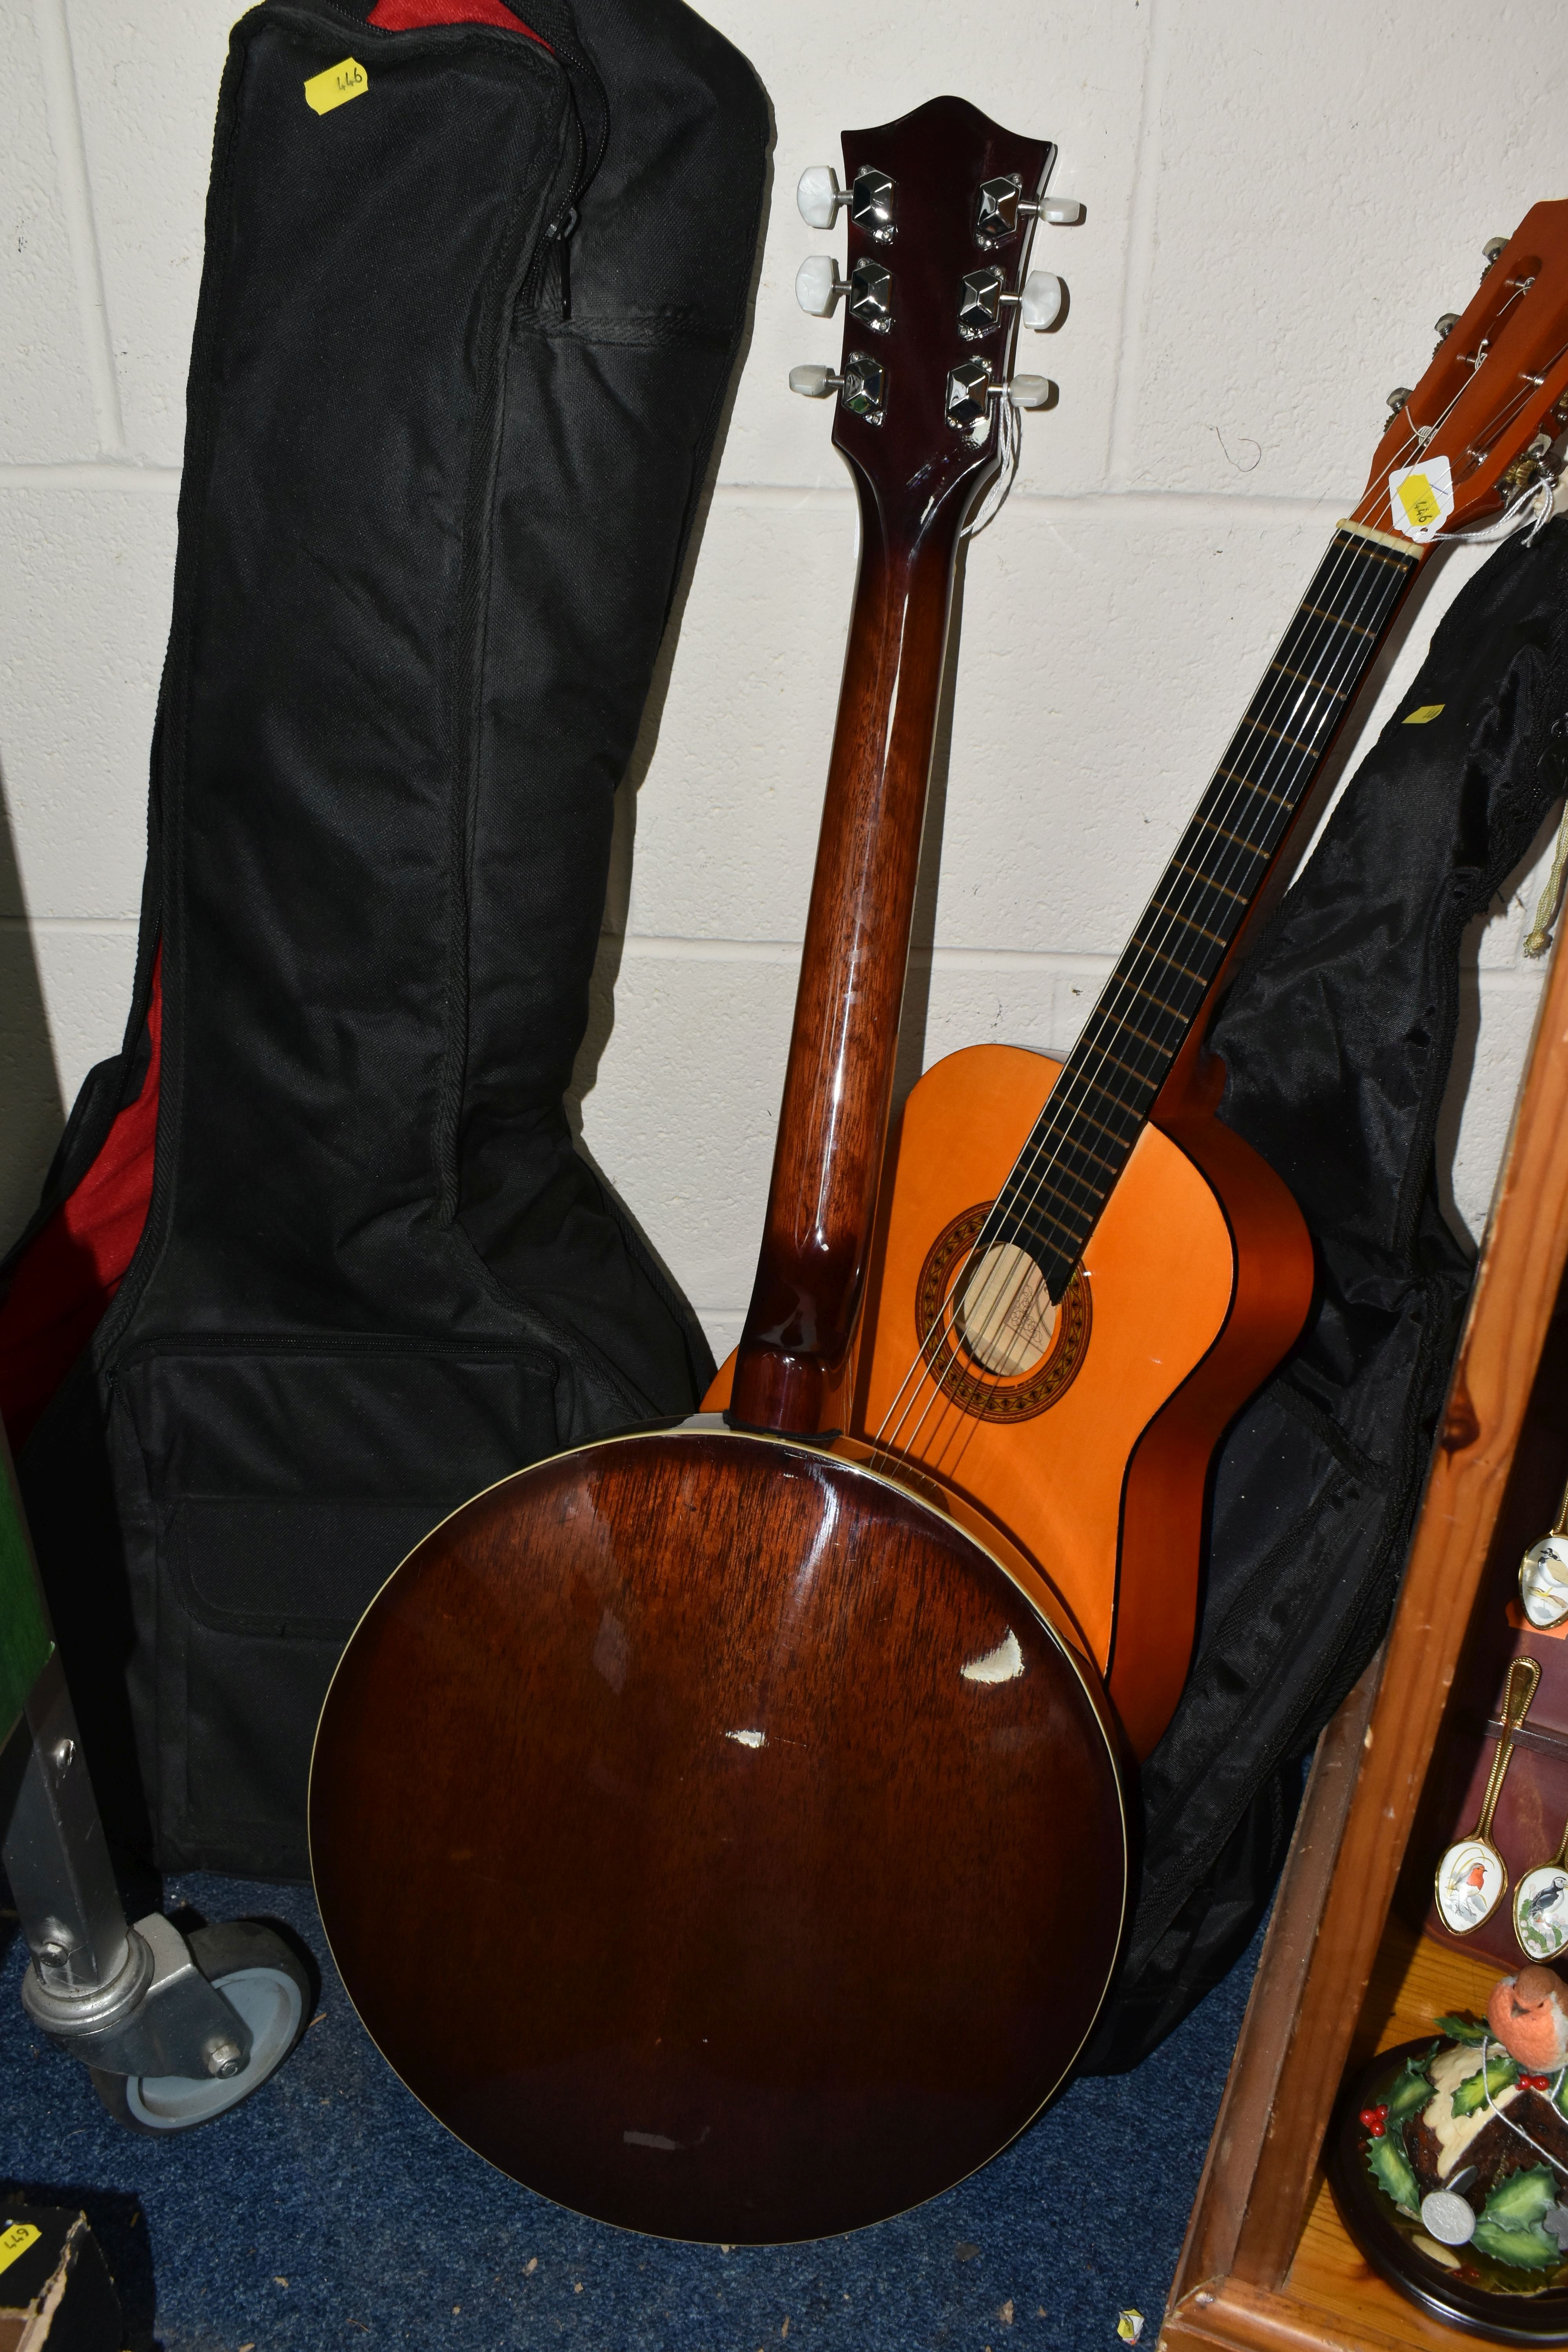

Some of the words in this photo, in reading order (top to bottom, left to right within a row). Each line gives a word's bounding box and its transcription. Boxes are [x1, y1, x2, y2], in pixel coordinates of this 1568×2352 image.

[337, 67, 363, 91] 446
[1414, 501, 1433, 523] 446
[4, 2228, 29, 2249] 449
